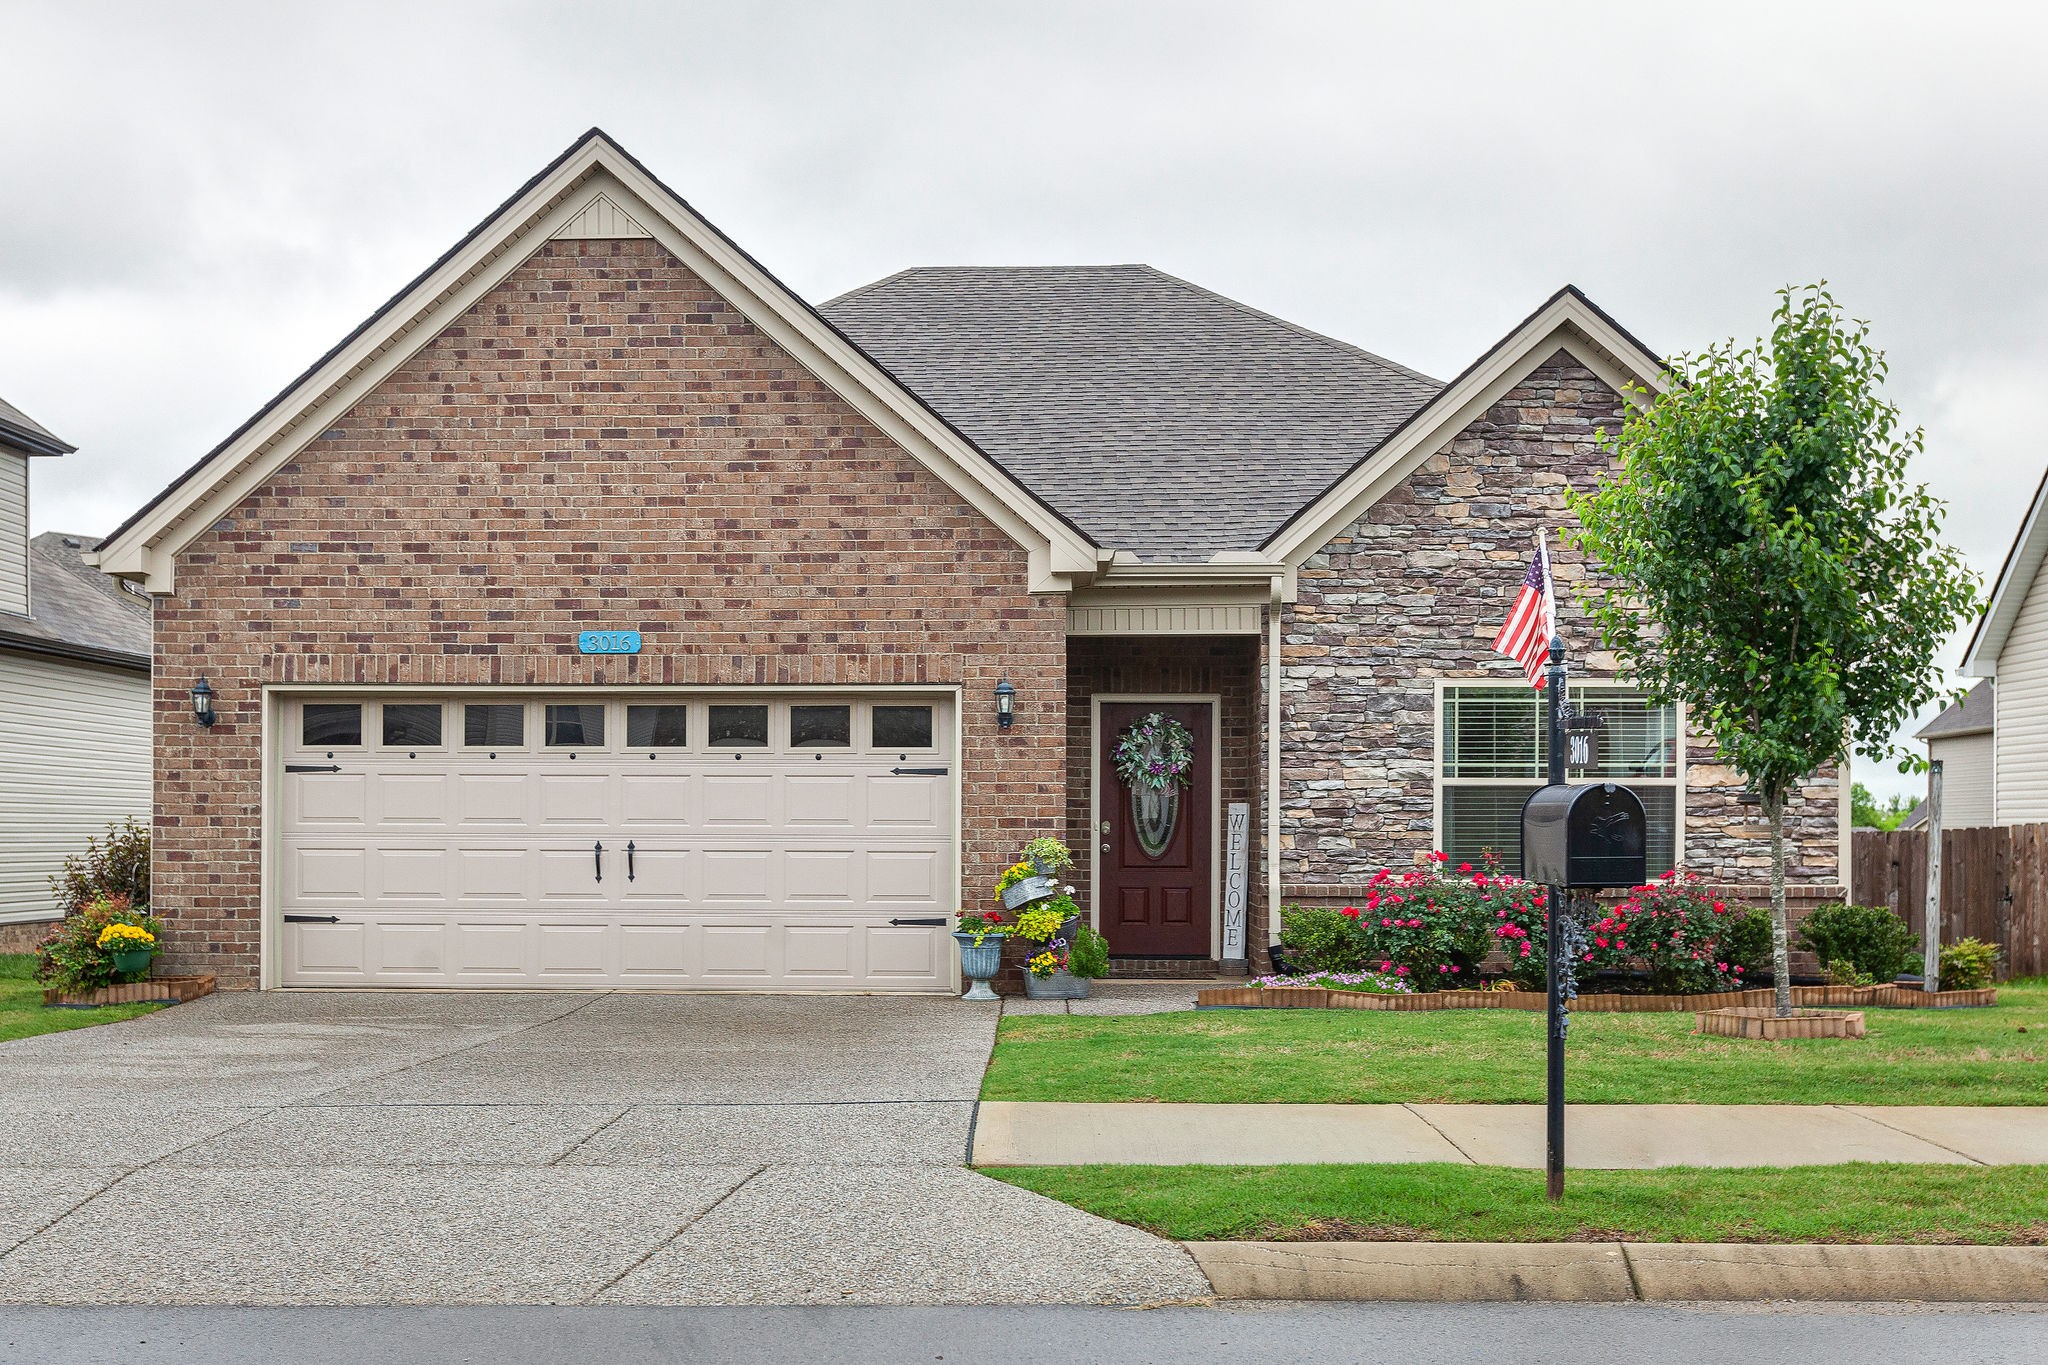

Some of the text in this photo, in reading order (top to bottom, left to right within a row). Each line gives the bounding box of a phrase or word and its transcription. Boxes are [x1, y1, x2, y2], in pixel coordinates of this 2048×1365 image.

[587, 634, 631, 651] 3016
[1569, 735, 1589, 764] 3016
[1225, 813, 1246, 947] WELCOME
